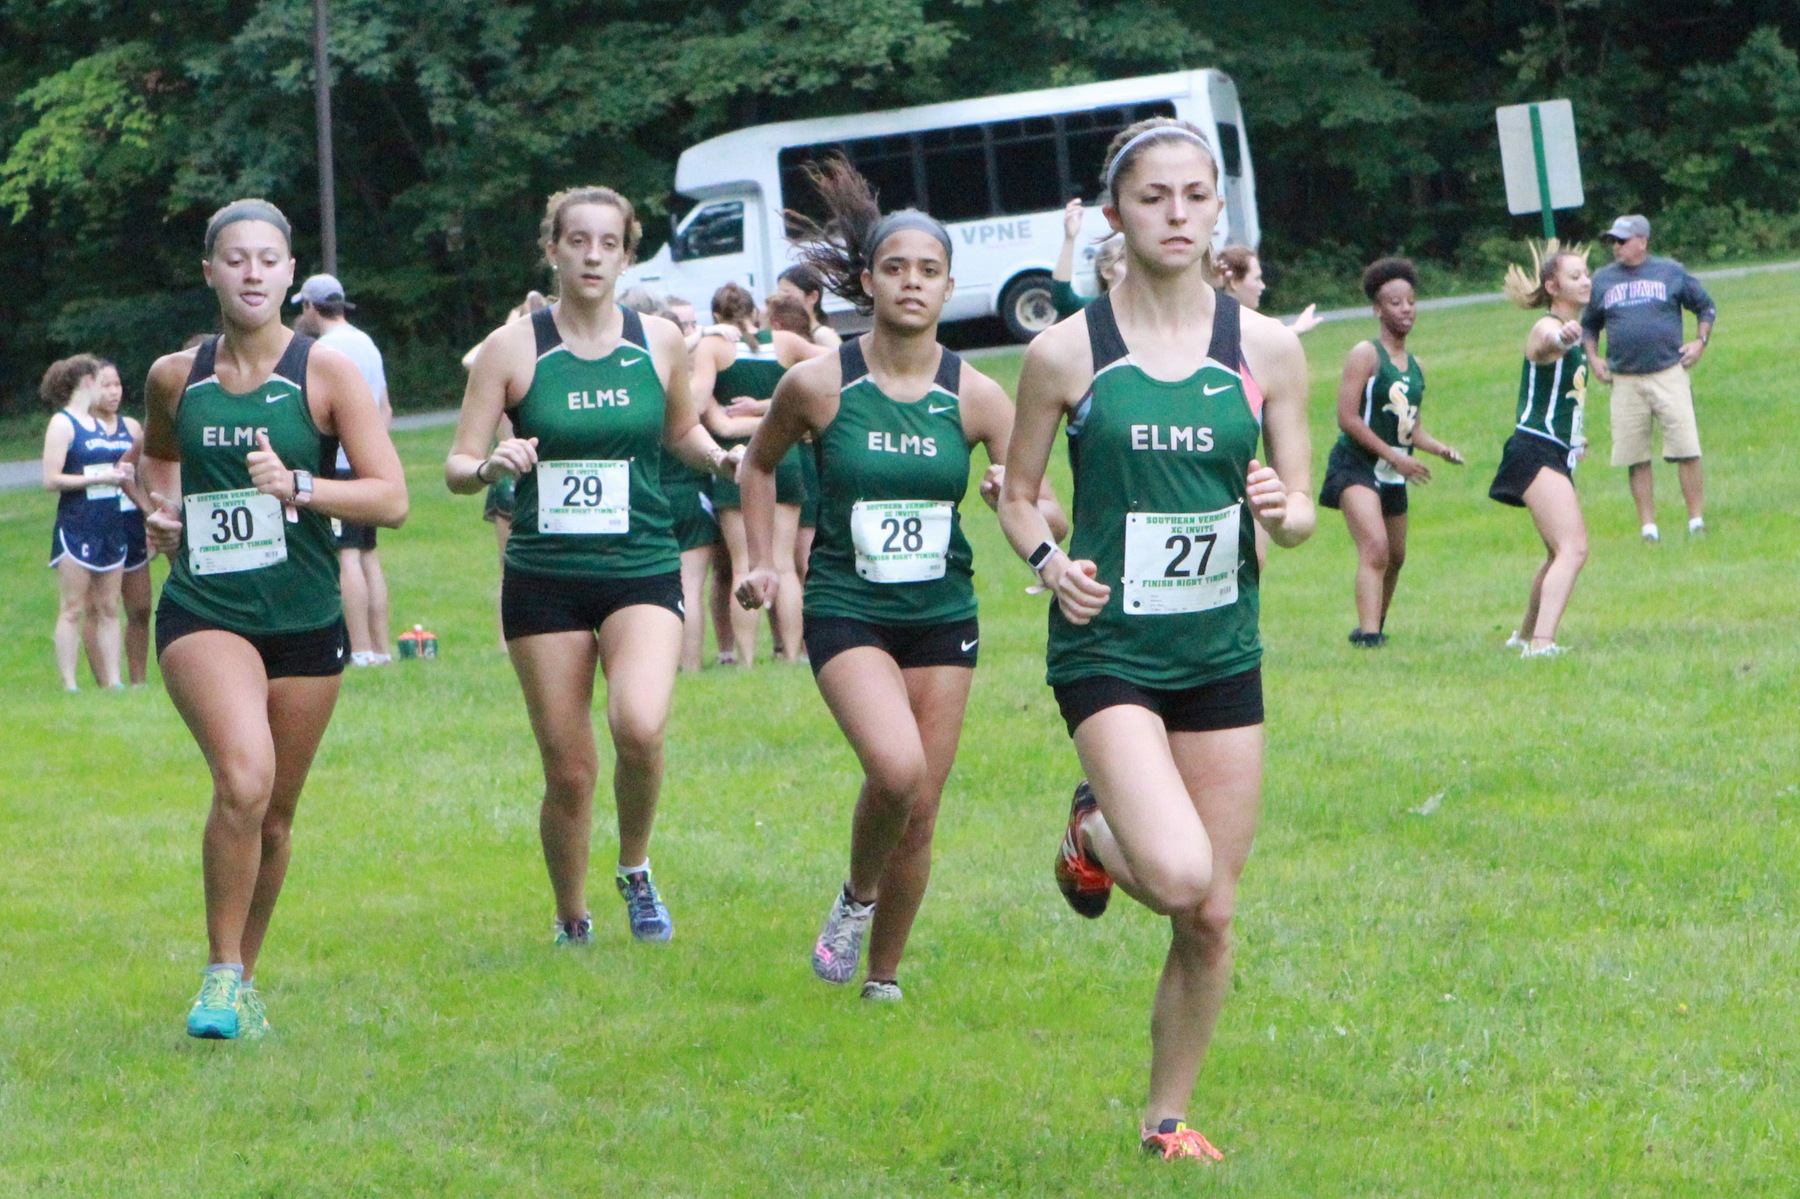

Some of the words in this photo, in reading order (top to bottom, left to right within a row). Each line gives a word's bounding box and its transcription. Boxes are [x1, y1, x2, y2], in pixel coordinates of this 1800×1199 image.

[961, 220, 1032, 245] VPNE
[1629, 280, 1666, 301] PATH
[567, 389, 630, 410] ELMS
[868, 431, 938, 457] ELMS
[1130, 424, 1214, 453] ELMS
[563, 475, 602, 507] 29
[211, 506, 254, 544] 30
[1146, 516, 1195, 525] SOUTHERN
[1198, 510, 1231, 523] VERMONT
[1171, 526, 1182, 534] XC
[1185, 524, 1214, 533] INVITE
[880, 517, 923, 553] 28
[1164, 533, 1217, 578] 27
[1142, 580, 1173, 588] FINISH
[1176, 577, 1203, 586] RIGHT
[1205, 571, 1229, 584] TIMING
